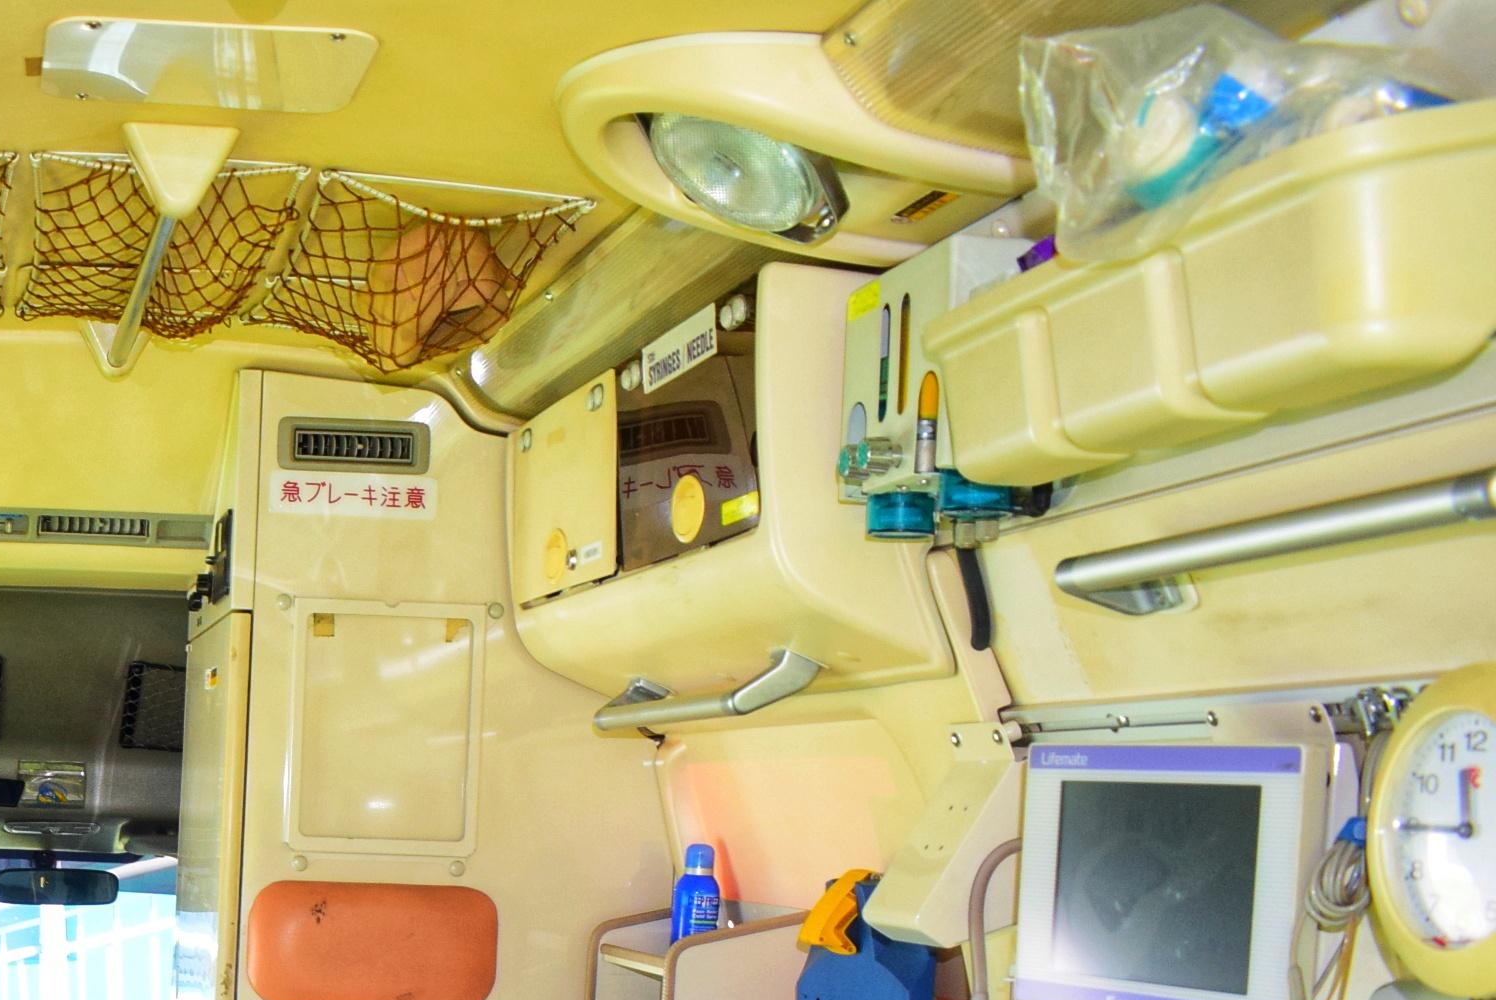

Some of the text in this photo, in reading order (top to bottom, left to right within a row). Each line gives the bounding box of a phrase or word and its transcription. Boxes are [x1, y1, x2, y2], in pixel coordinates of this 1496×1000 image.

[649, 328, 714, 386] SYRINGES NEEDLE
[280, 480, 426, 509] 急ブレーキ注意
[1464, 730, 1488, 752] 12
[1041, 751, 1088, 766] Lifemate
[1440, 743, 1457, 763] 11
[1417, 773, 1439, 795] 10
